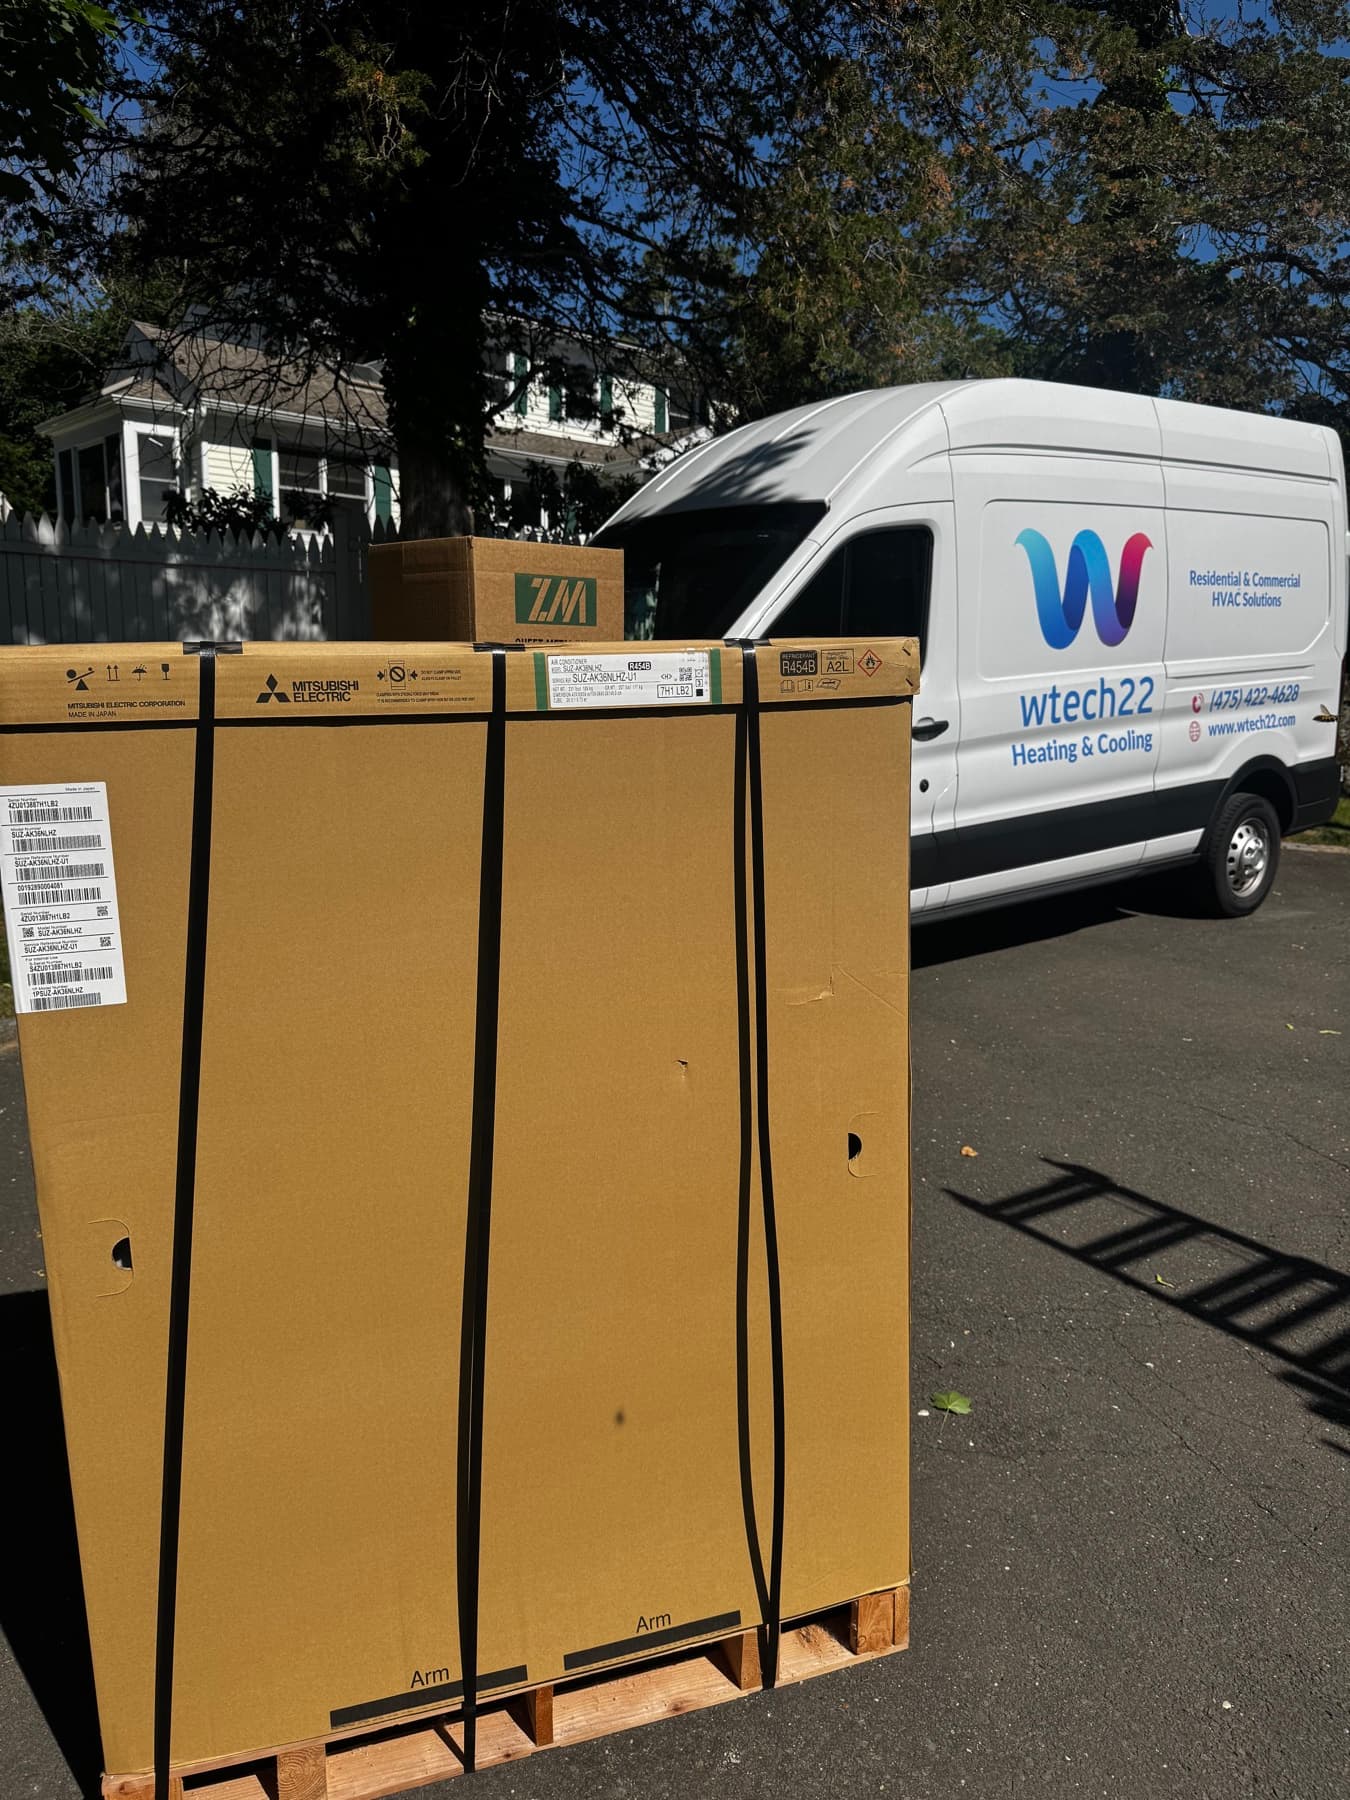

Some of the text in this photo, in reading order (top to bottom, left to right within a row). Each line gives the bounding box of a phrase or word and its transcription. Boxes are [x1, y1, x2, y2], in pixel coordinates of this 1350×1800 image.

[1189, 569, 1301, 588] Residential & Commercial
[528, 577, 587, 624] ZM
[1212, 591, 1282, 608] HVAC Solutions
[630, 662, 650, 670] R454B
[782, 660, 816, 674] R454B
[826, 660, 849, 673] A2L
[292, 680, 359, 692] MITSUBISHI
[572, 672, 637, 683] SUZ-AK36NLHZ-U1
[292, 691, 352, 703] ELECTRIC
[660, 686, 690, 696] 7H1 LB2
[1208, 684, 1300, 712] (475) 422-4628
[138, 700, 186, 708] CORPORATION
[1020, 676, 1154, 727] wtech22
[1208, 714, 1296, 737] www.wtech22.com
[1011, 730, 1153, 766] Heating & Cooling
[635, 1612, 672, 1634] Arm
[410, 1666, 450, 1688] Arm
